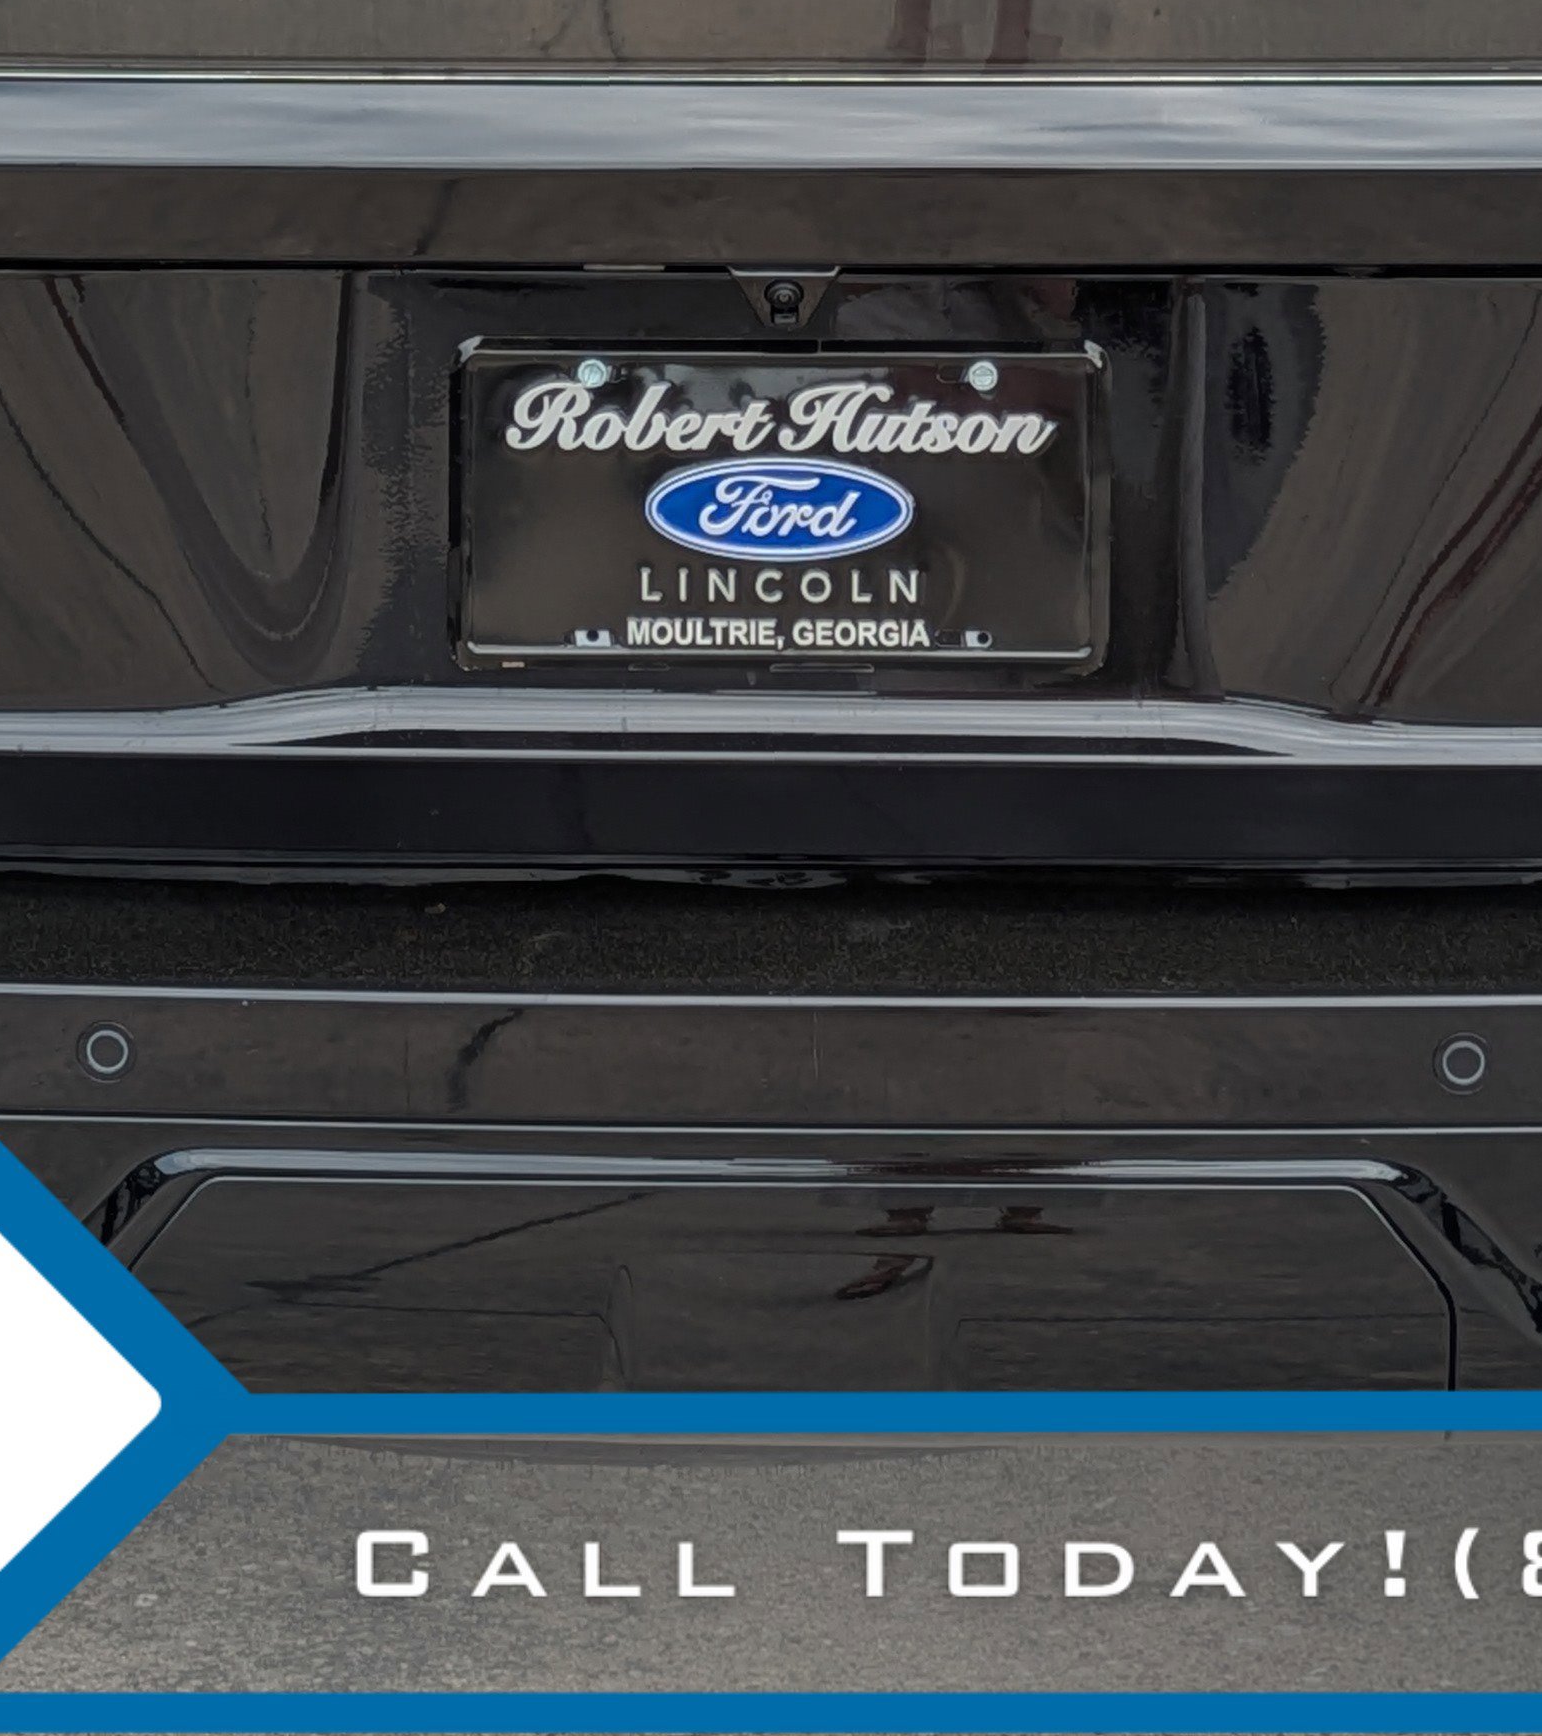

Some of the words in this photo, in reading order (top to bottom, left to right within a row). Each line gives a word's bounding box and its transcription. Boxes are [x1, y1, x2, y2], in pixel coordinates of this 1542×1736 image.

[505, 381, 774, 451] Robert
[777, 381, 1057, 455] Hutson
[697, 475, 862, 539] Ford
[641, 568, 918, 603] LINCOLN
[627, 618, 785, 650] MOULTRIE,
[792, 620, 930, 646] GEORGIA
